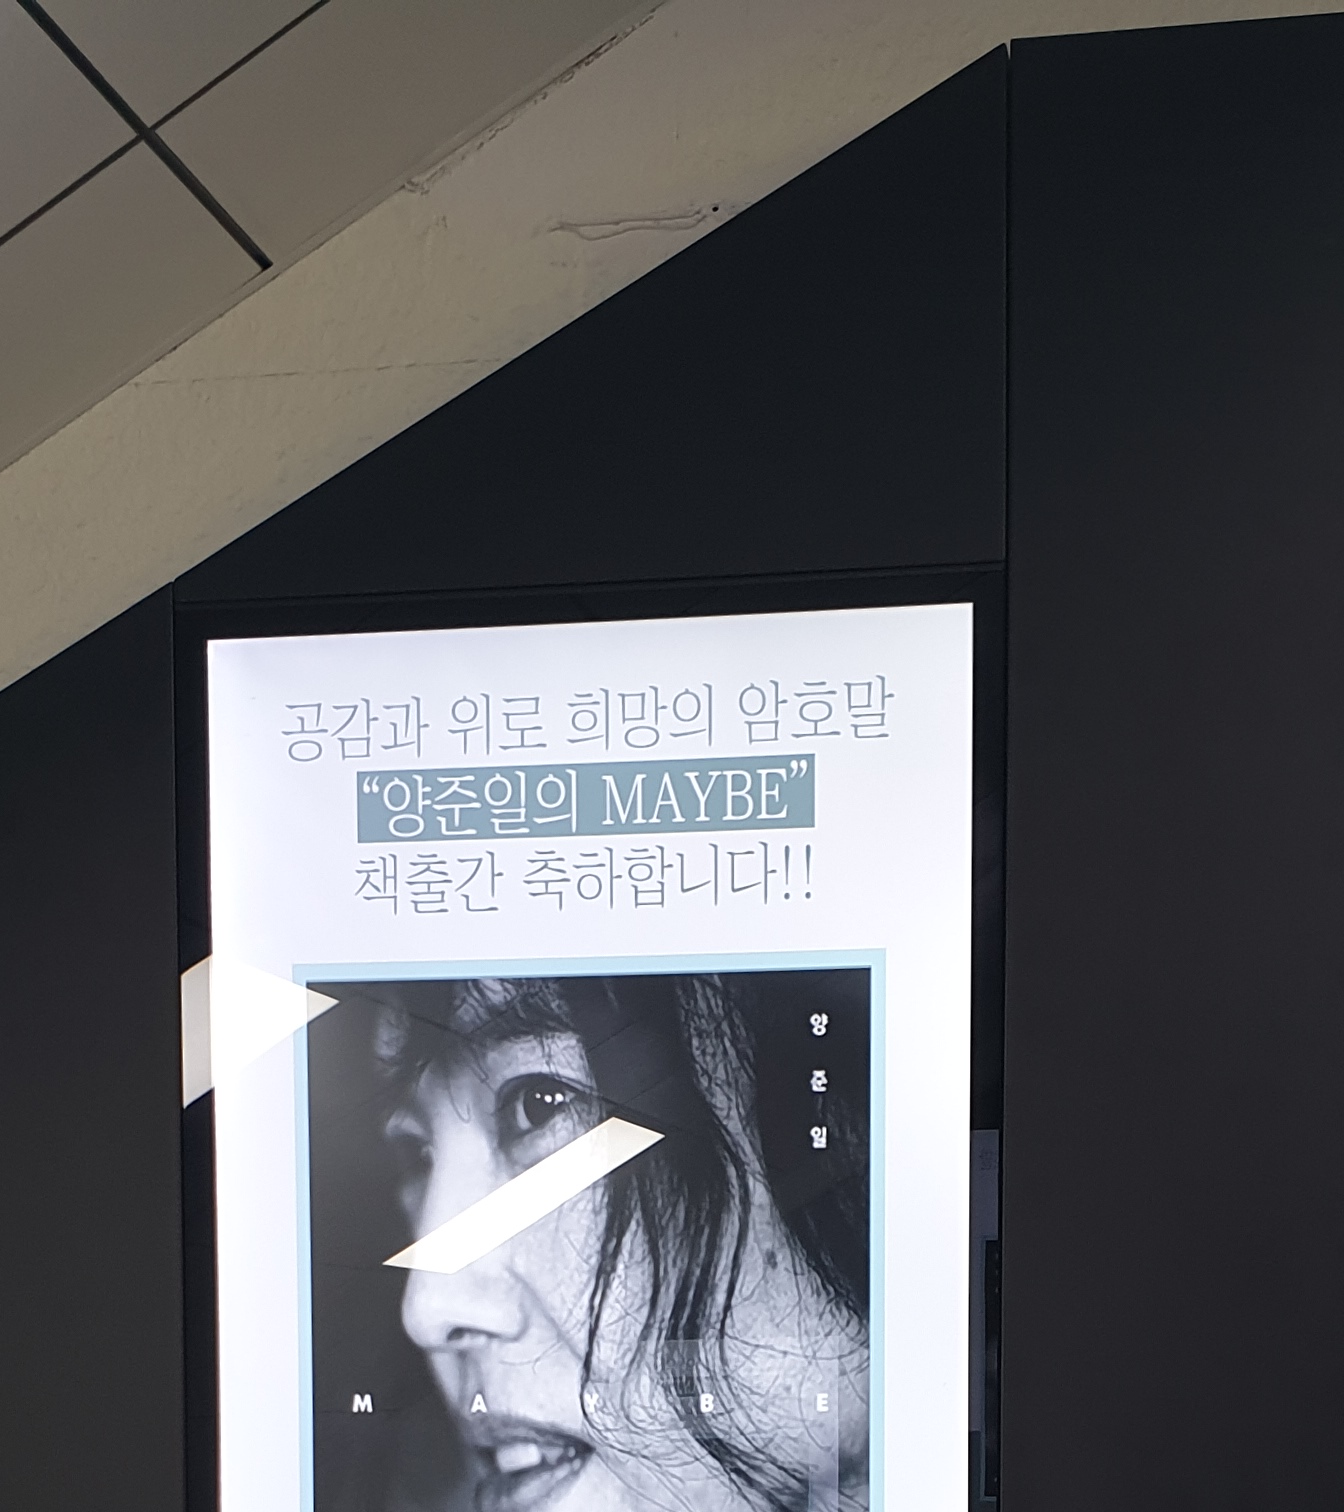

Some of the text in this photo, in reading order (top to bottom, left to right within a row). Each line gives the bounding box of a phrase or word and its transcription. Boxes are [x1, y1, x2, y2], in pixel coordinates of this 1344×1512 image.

[281, 674, 895, 762] 공감과 위로 희망의 암호말
[360, 758, 810, 839] “양준일의 MAYBE”
[355, 840, 813, 916] 책출간 축하합니다!!
